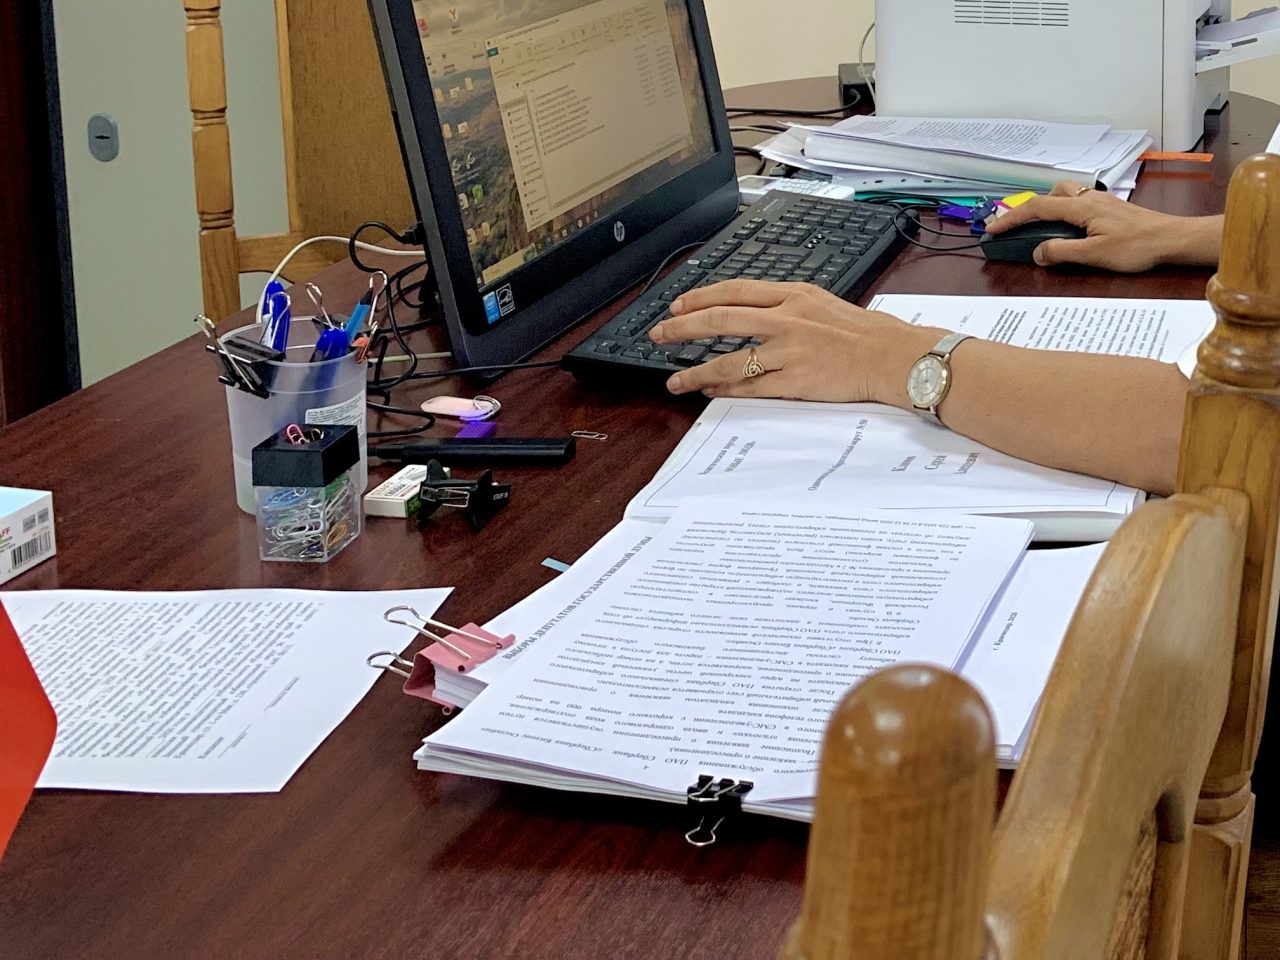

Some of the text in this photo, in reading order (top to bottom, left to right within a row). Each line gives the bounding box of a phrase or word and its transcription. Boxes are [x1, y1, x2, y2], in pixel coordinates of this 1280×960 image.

[502, 636, 538, 659] ВЫБОРЫ
[533, 604, 578, 638] ДЕПУТАТОВ
[573, 552, 636, 605] ГОСУДАРСТВЕННОЙ
[631, 536, 654, 553] ДУМЫ
[611, 749, 656, 761] Сбербанк
[759, 744, 815, 755] Подписание
